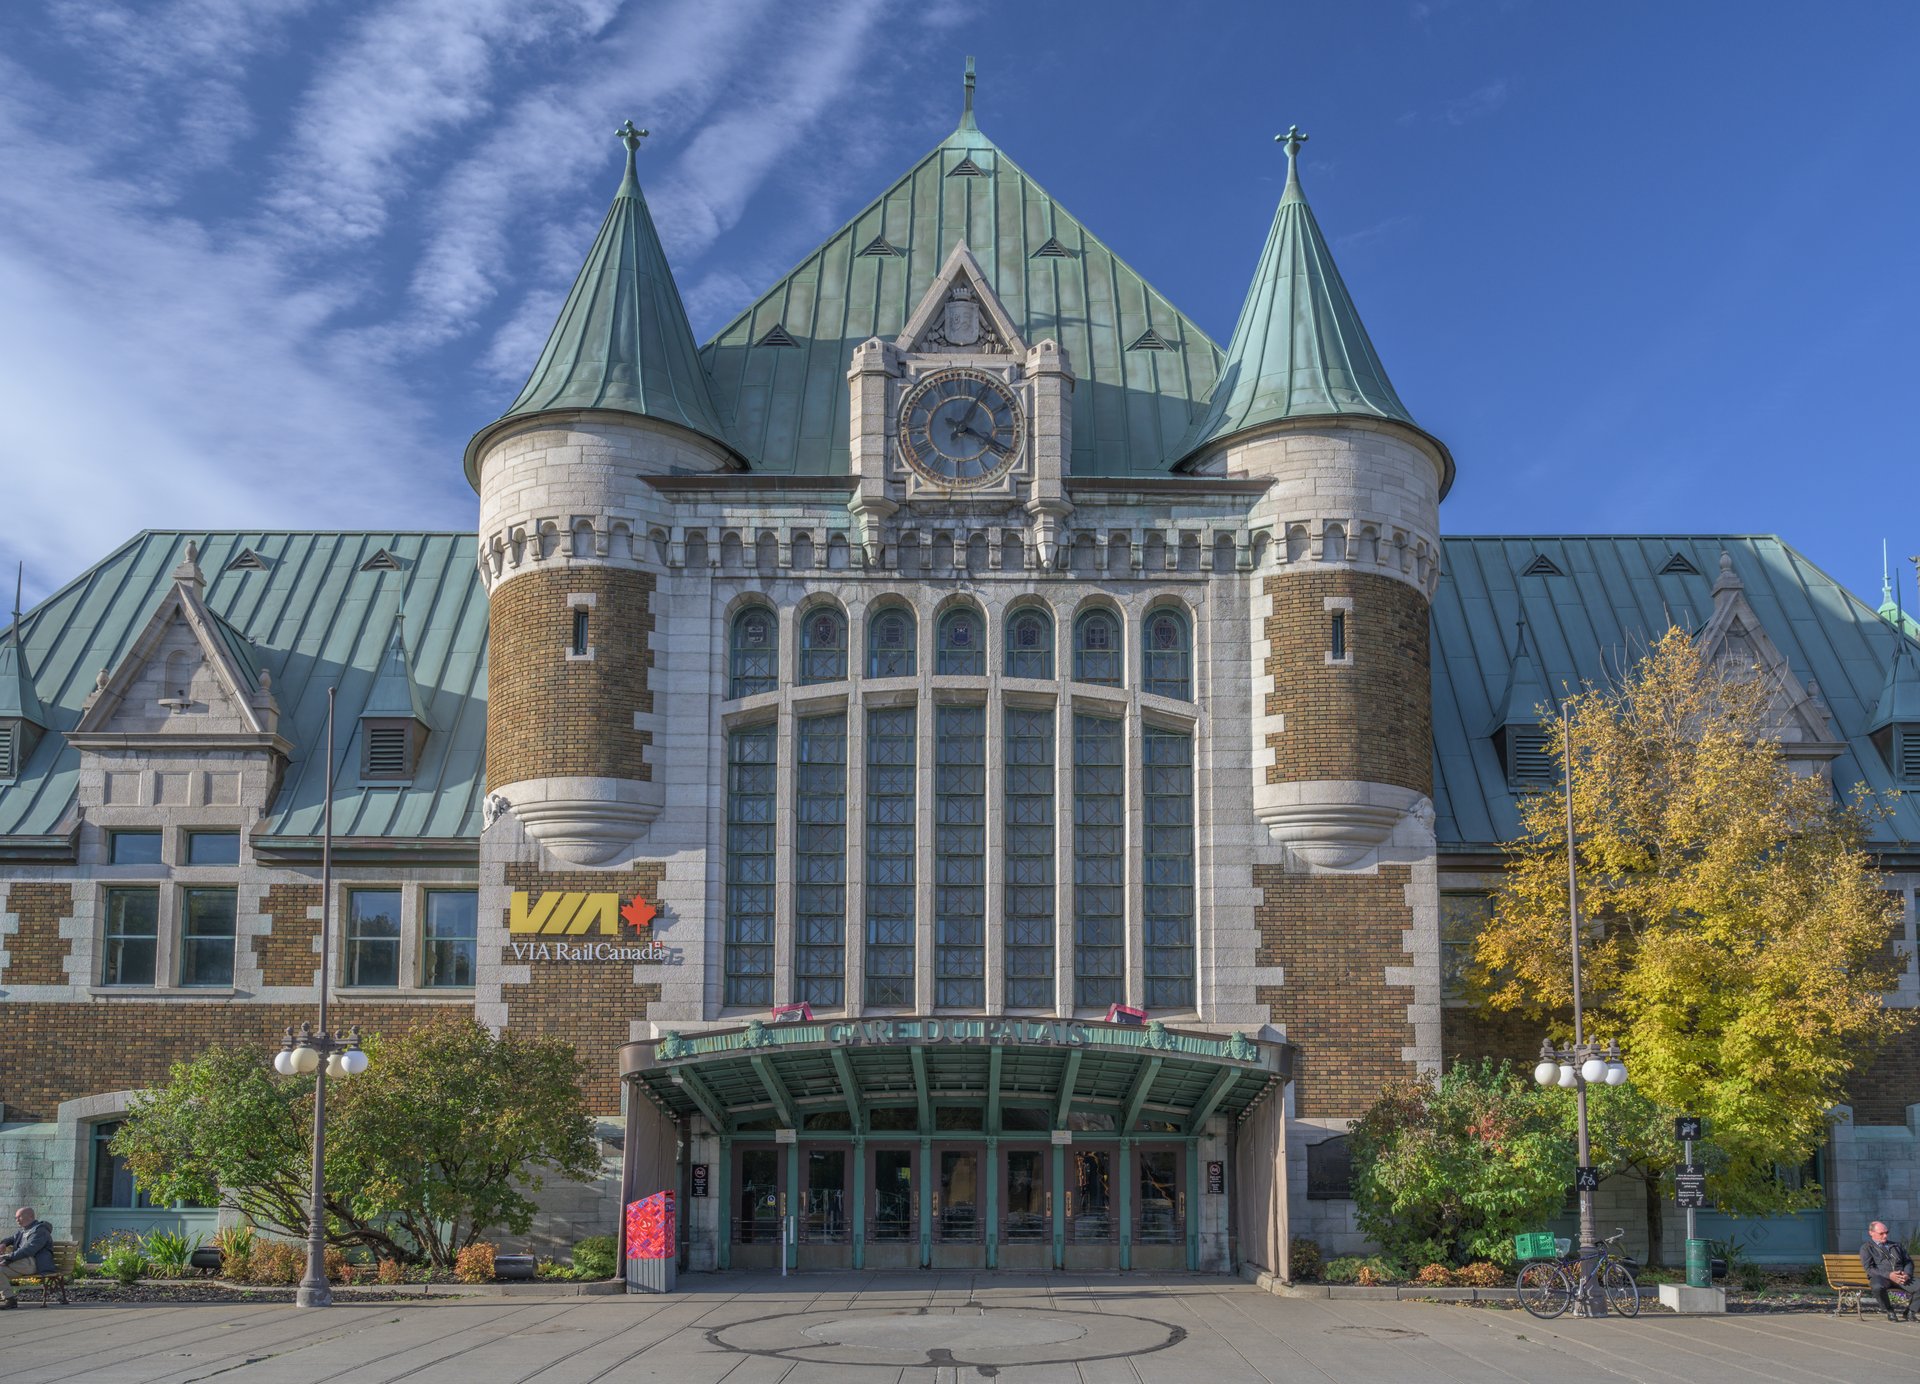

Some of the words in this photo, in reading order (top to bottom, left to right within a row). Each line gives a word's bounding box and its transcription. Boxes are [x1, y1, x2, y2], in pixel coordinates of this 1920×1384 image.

[510, 891, 619, 935] VIA
[511, 942, 551, 961] VIA
[825, 1019, 912, 1047] GARE
[920, 1018, 969, 1043] DU
[983, 1018, 1089, 1046] PALAIS
